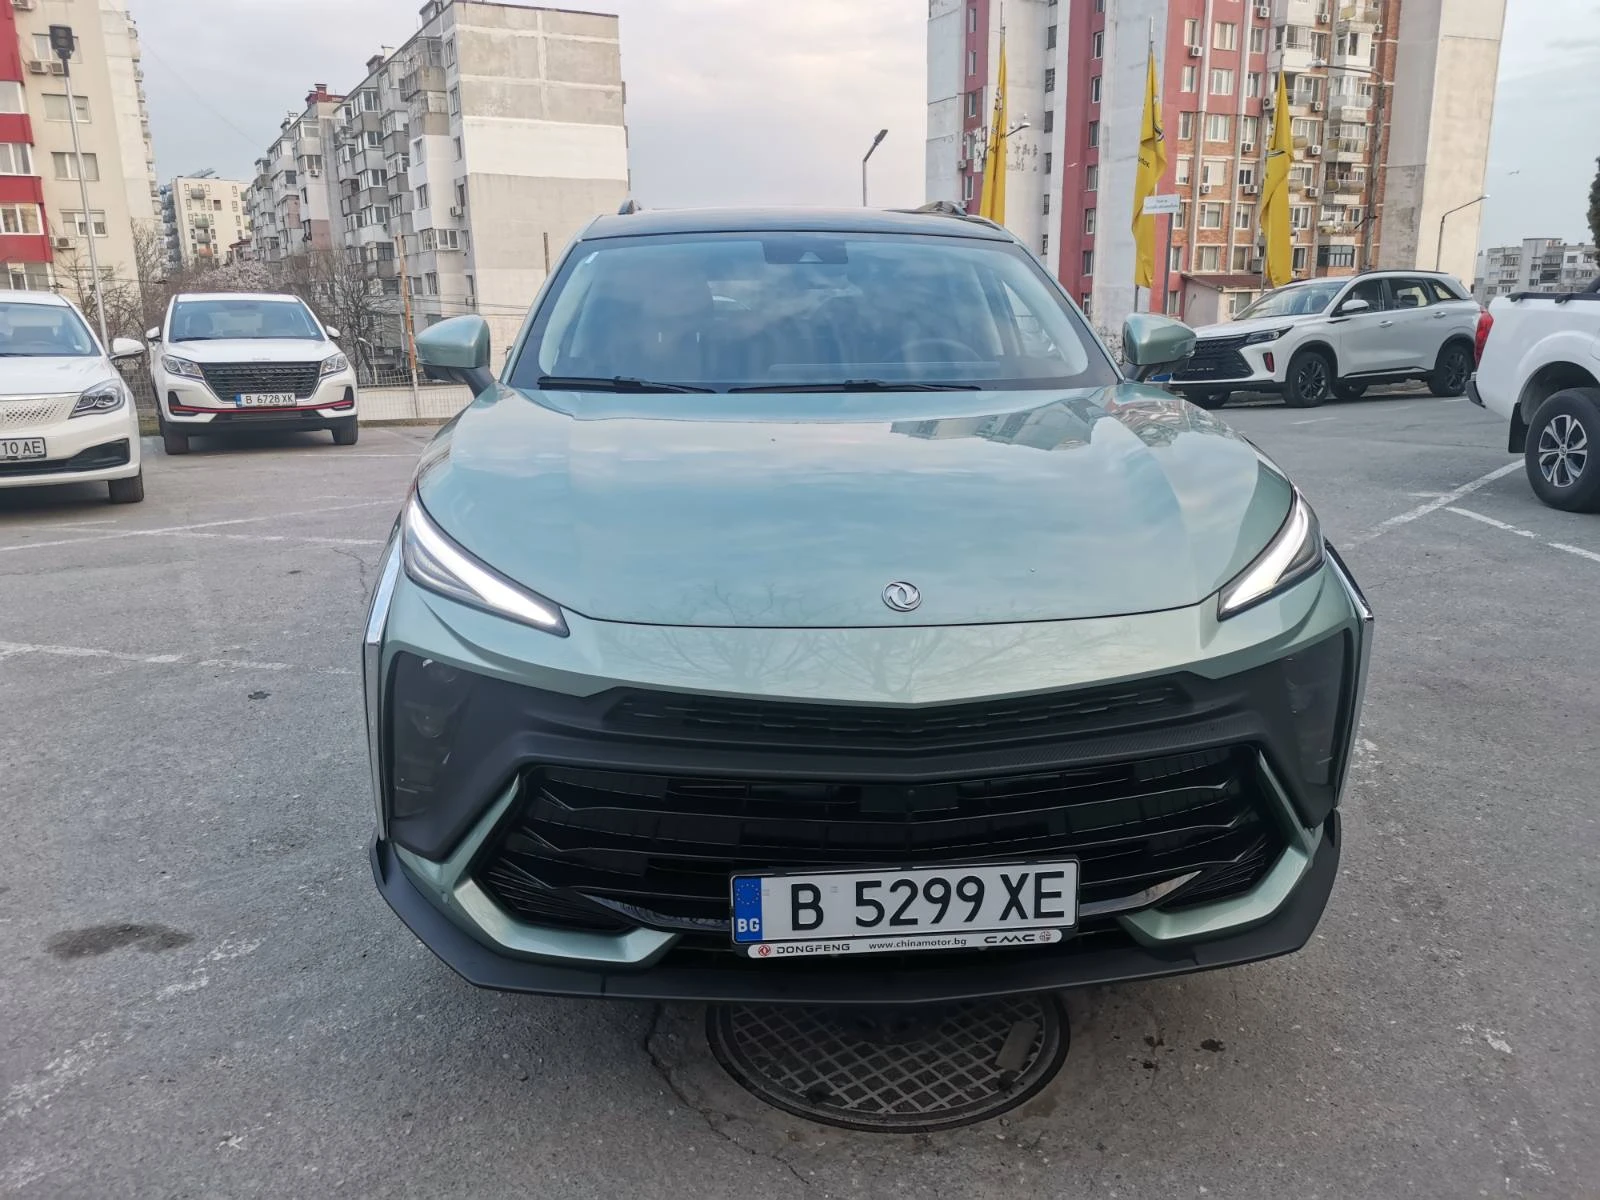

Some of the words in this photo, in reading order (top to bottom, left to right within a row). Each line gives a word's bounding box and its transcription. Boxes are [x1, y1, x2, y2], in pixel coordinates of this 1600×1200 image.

[245, 395, 253, 404] B
[257, 394, 281, 404] 6728
[282, 394, 293, 403] XK
[23, 440, 43, 454] AE
[791, 883, 824, 931] B
[855, 875, 985, 928] 5299
[999, 871, 1065, 921] XE
[737, 918, 760, 932] BG
[776, 943, 851, 954] DONGFENG
[869, 937, 967, 949] www.chinamotor.bg
[984, 934, 1035, 944] CMC
